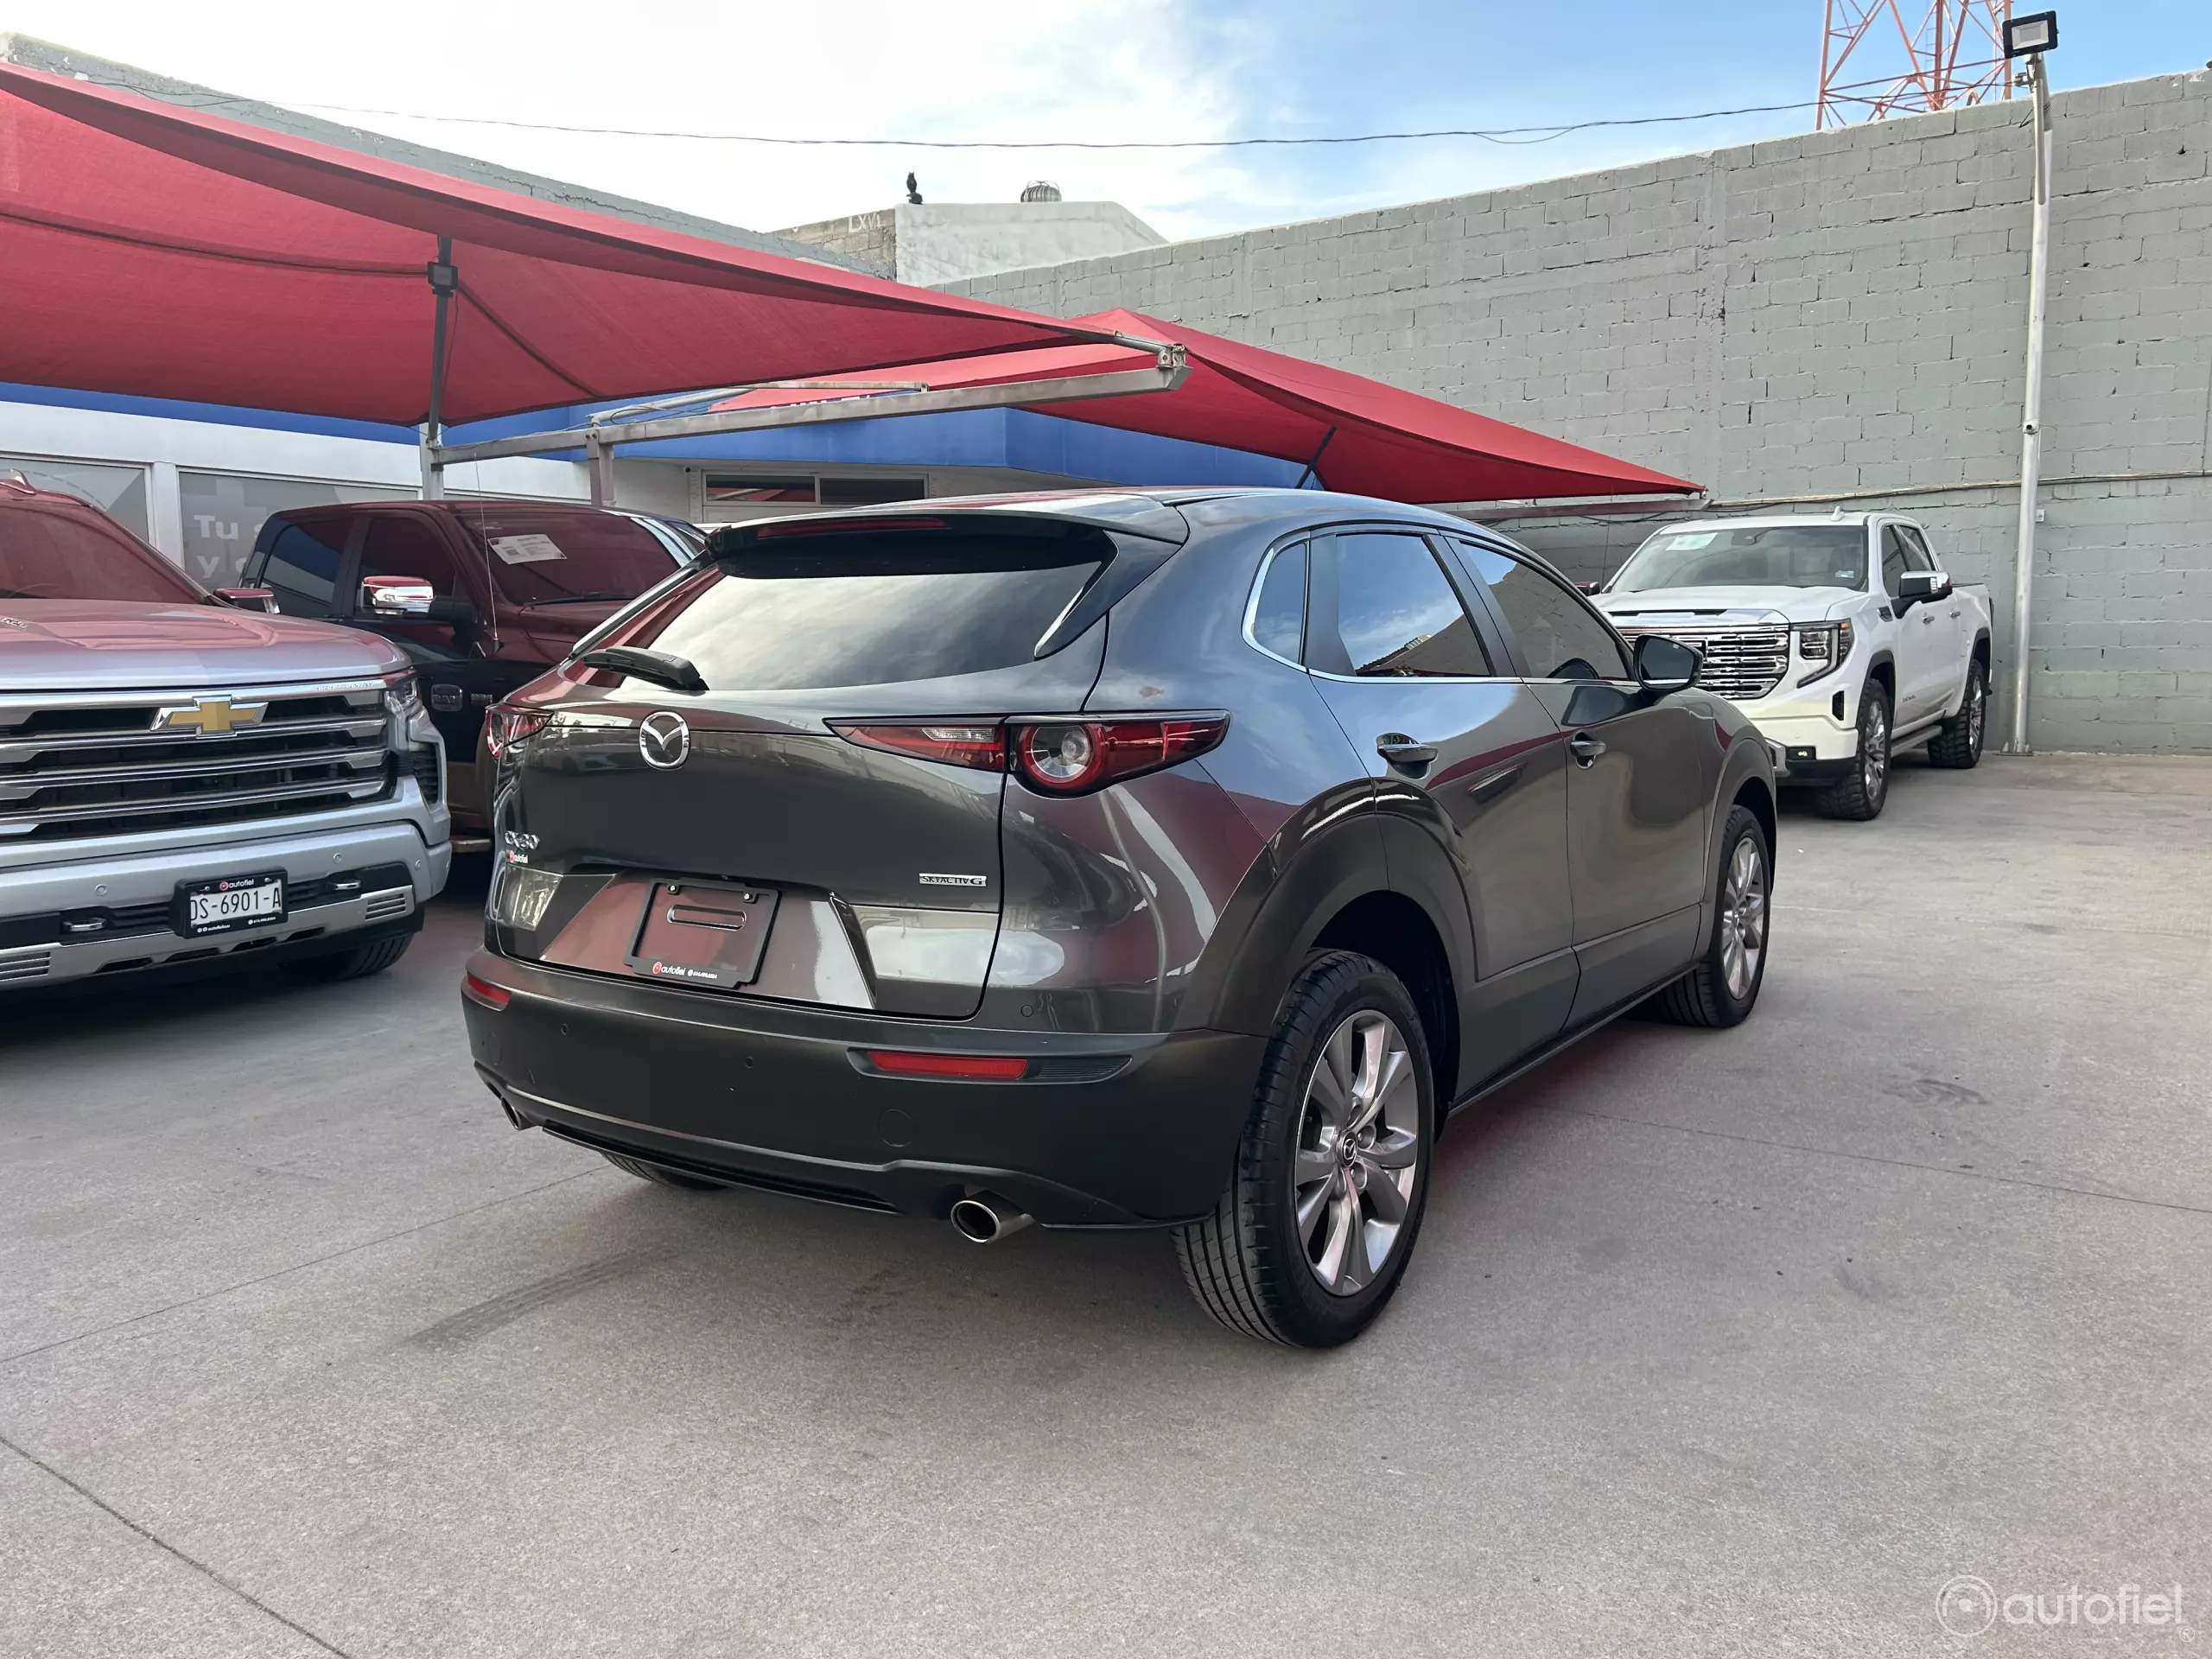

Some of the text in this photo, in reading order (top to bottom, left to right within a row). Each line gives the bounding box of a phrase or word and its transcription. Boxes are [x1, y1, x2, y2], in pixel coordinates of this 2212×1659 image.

[194, 514, 238, 540] Tu
[228, 879, 255, 888] autofiel
[661, 965, 687, 976] autofiel
